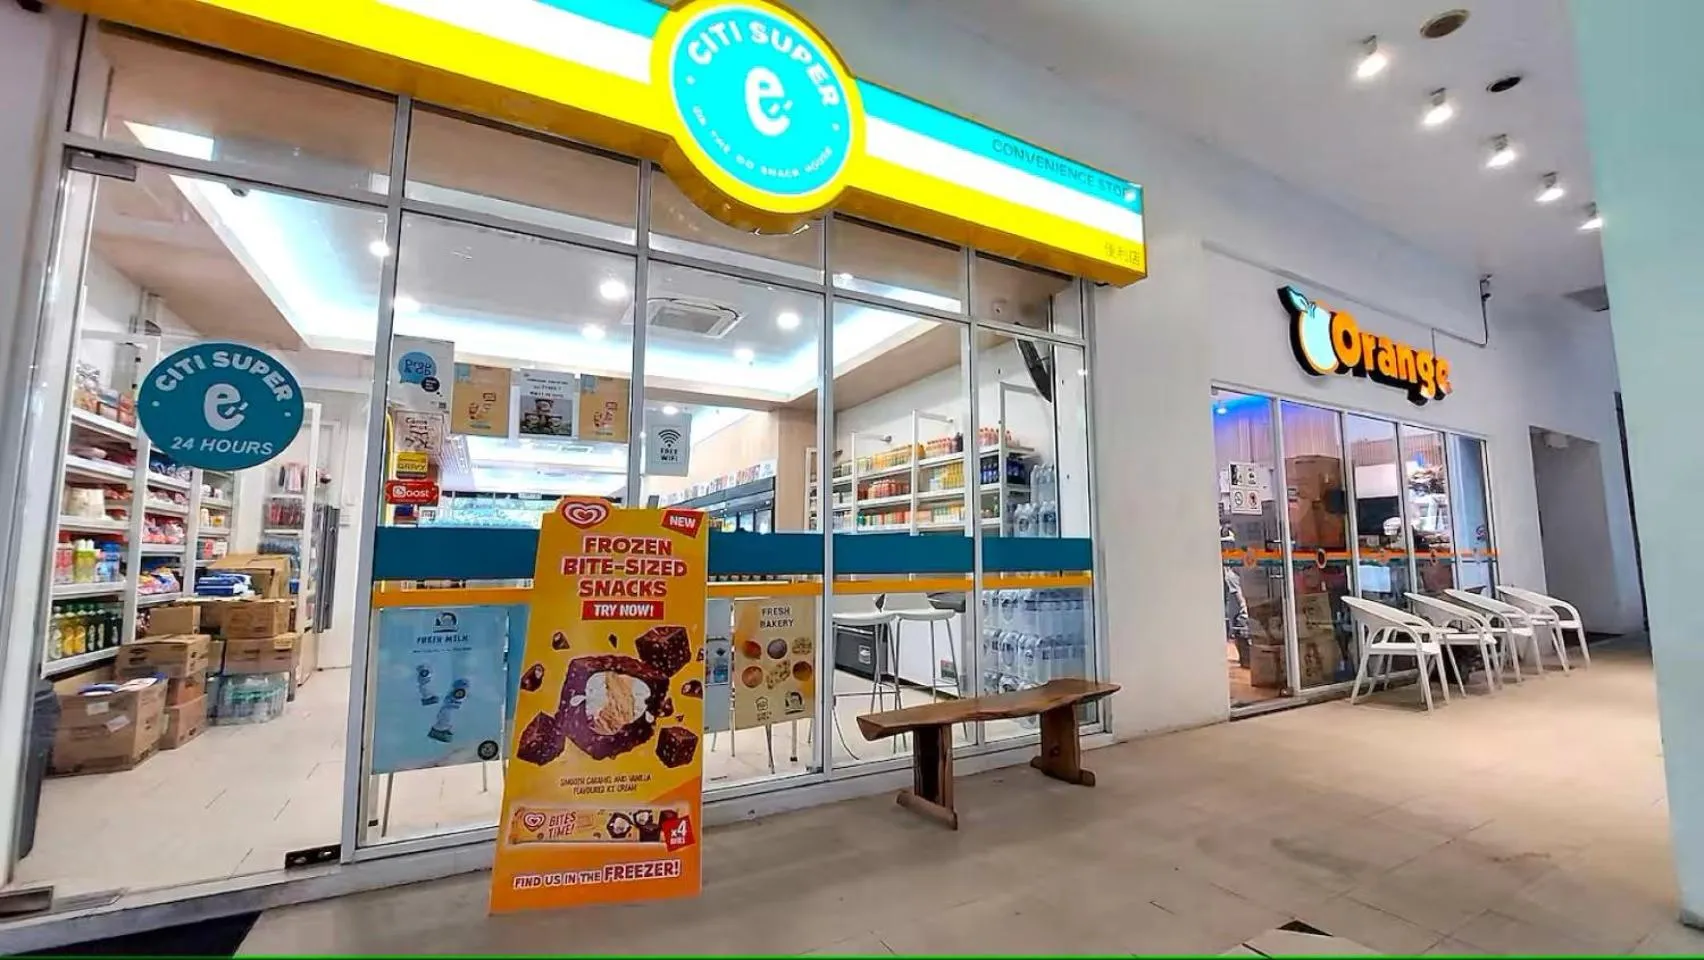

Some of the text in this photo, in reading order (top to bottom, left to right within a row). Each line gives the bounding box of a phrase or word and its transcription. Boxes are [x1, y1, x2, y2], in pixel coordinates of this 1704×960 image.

[687, 20, 840, 107] CITI SUPER
[992, 138, 1094, 186] CONVENIENCE
[1331, 309, 1453, 401] Orange
[155, 350, 293, 402] CITI SUPER
[171, 436, 273, 456] 24 HOURS
[660, 447, 678, 455] FREE
[669, 514, 696, 529] NEW
[584, 536, 672, 555] FROZEN
[563, 557, 688, 577] BITE-SIZED
[579, 579, 668, 598] SNACKS
[594, 603, 654, 617] TRY NOW!
[762, 606, 790, 616] FRESH
[760, 618, 794, 629] BAKERY
[549, 811, 577, 827] BITES
[548, 823, 575, 839] TIME!
[515, 860, 681, 889] FIND US IN THE FREEZER!
